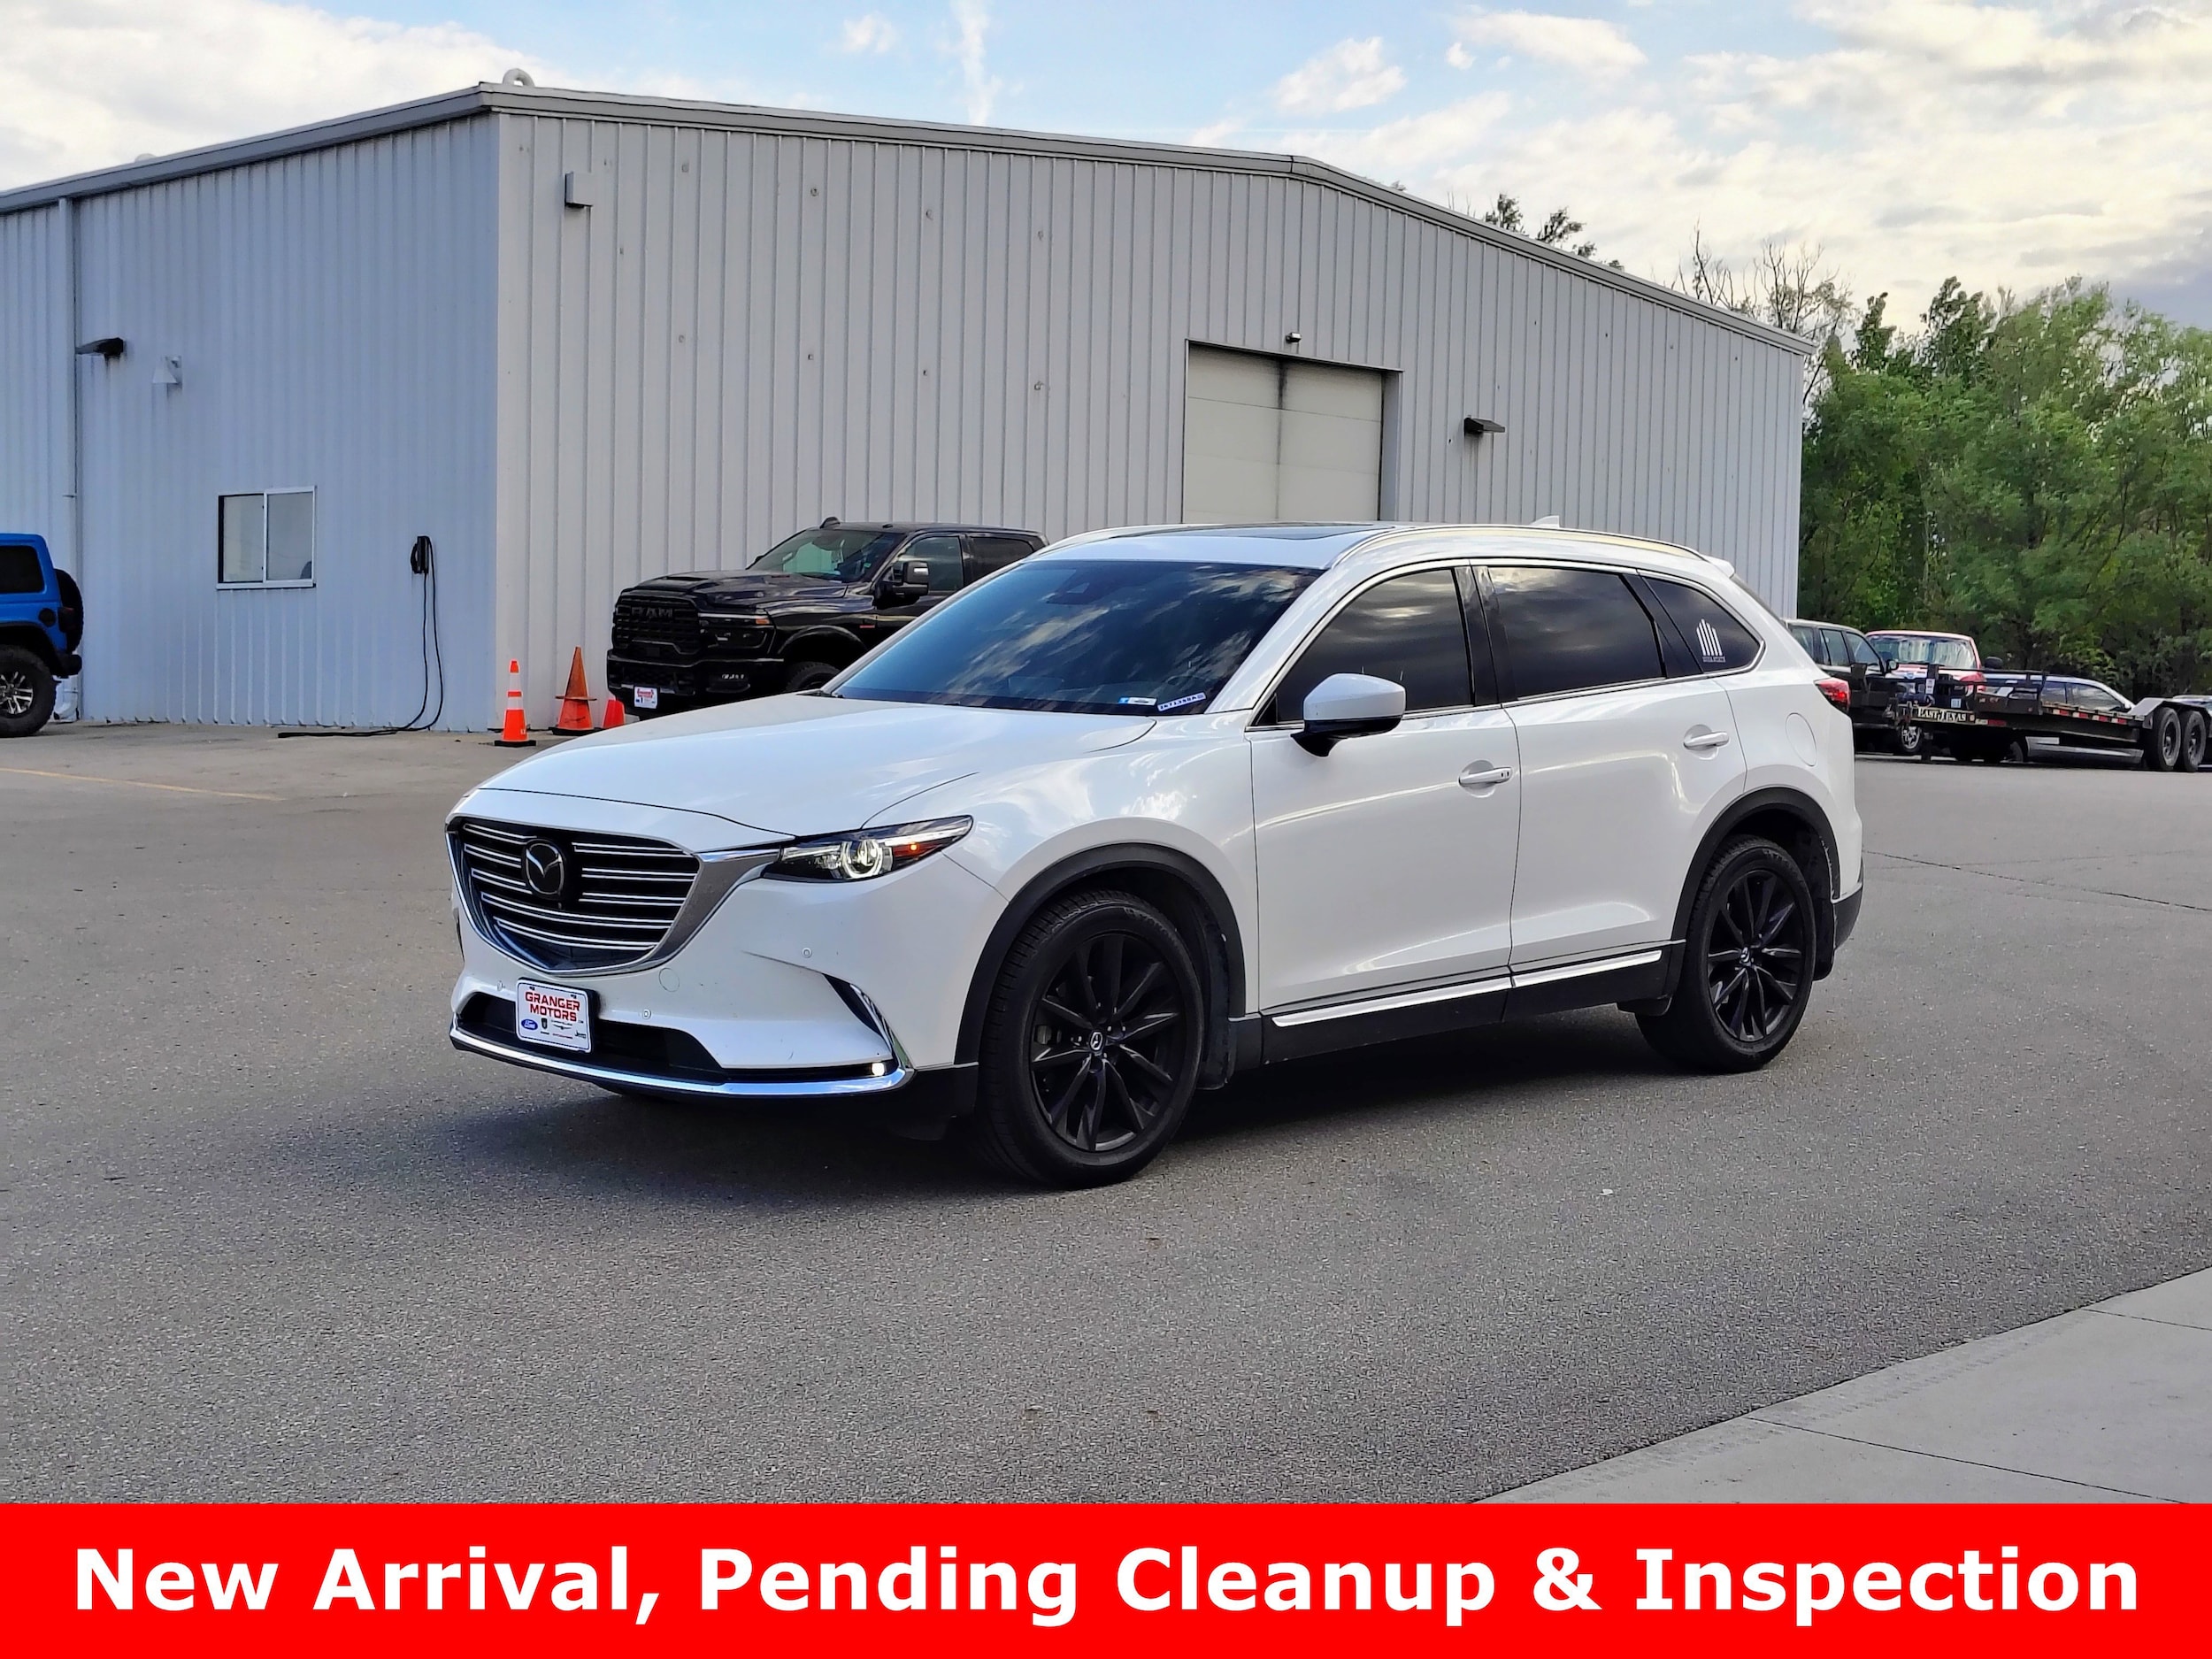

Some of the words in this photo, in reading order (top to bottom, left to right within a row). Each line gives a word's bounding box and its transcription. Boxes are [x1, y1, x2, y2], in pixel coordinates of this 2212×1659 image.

[631, 606, 672, 618] RAM
[1917, 707, 1939, 718] EAST
[1938, 709, 1966, 722] TEXAS
[526, 991, 580, 1012] GRANGER
[530, 1003, 578, 1023] MOTORS
